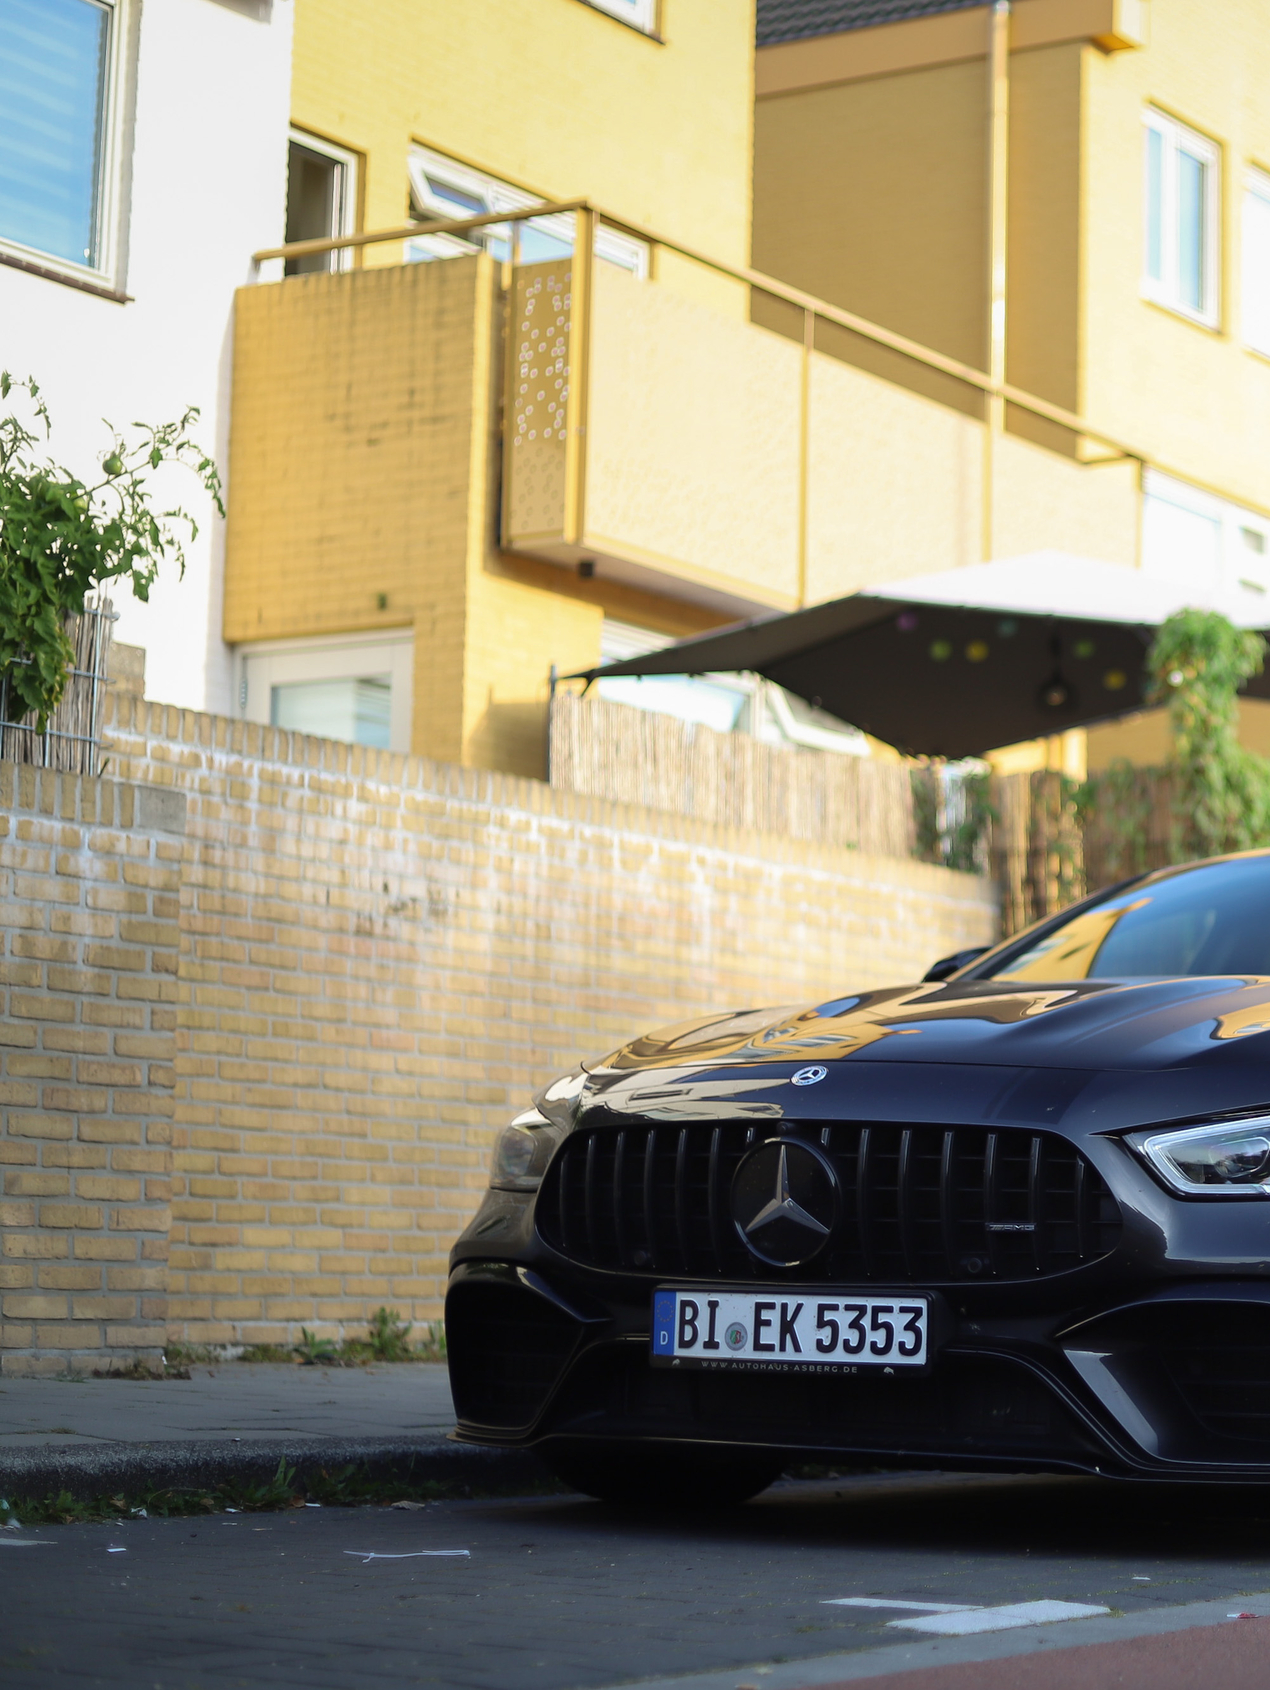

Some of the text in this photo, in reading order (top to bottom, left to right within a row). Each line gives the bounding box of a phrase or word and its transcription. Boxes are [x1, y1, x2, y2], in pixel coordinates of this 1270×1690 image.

[660, 1331, 668, 1345] D
[678, 1299, 924, 1356] BI EK 5353
